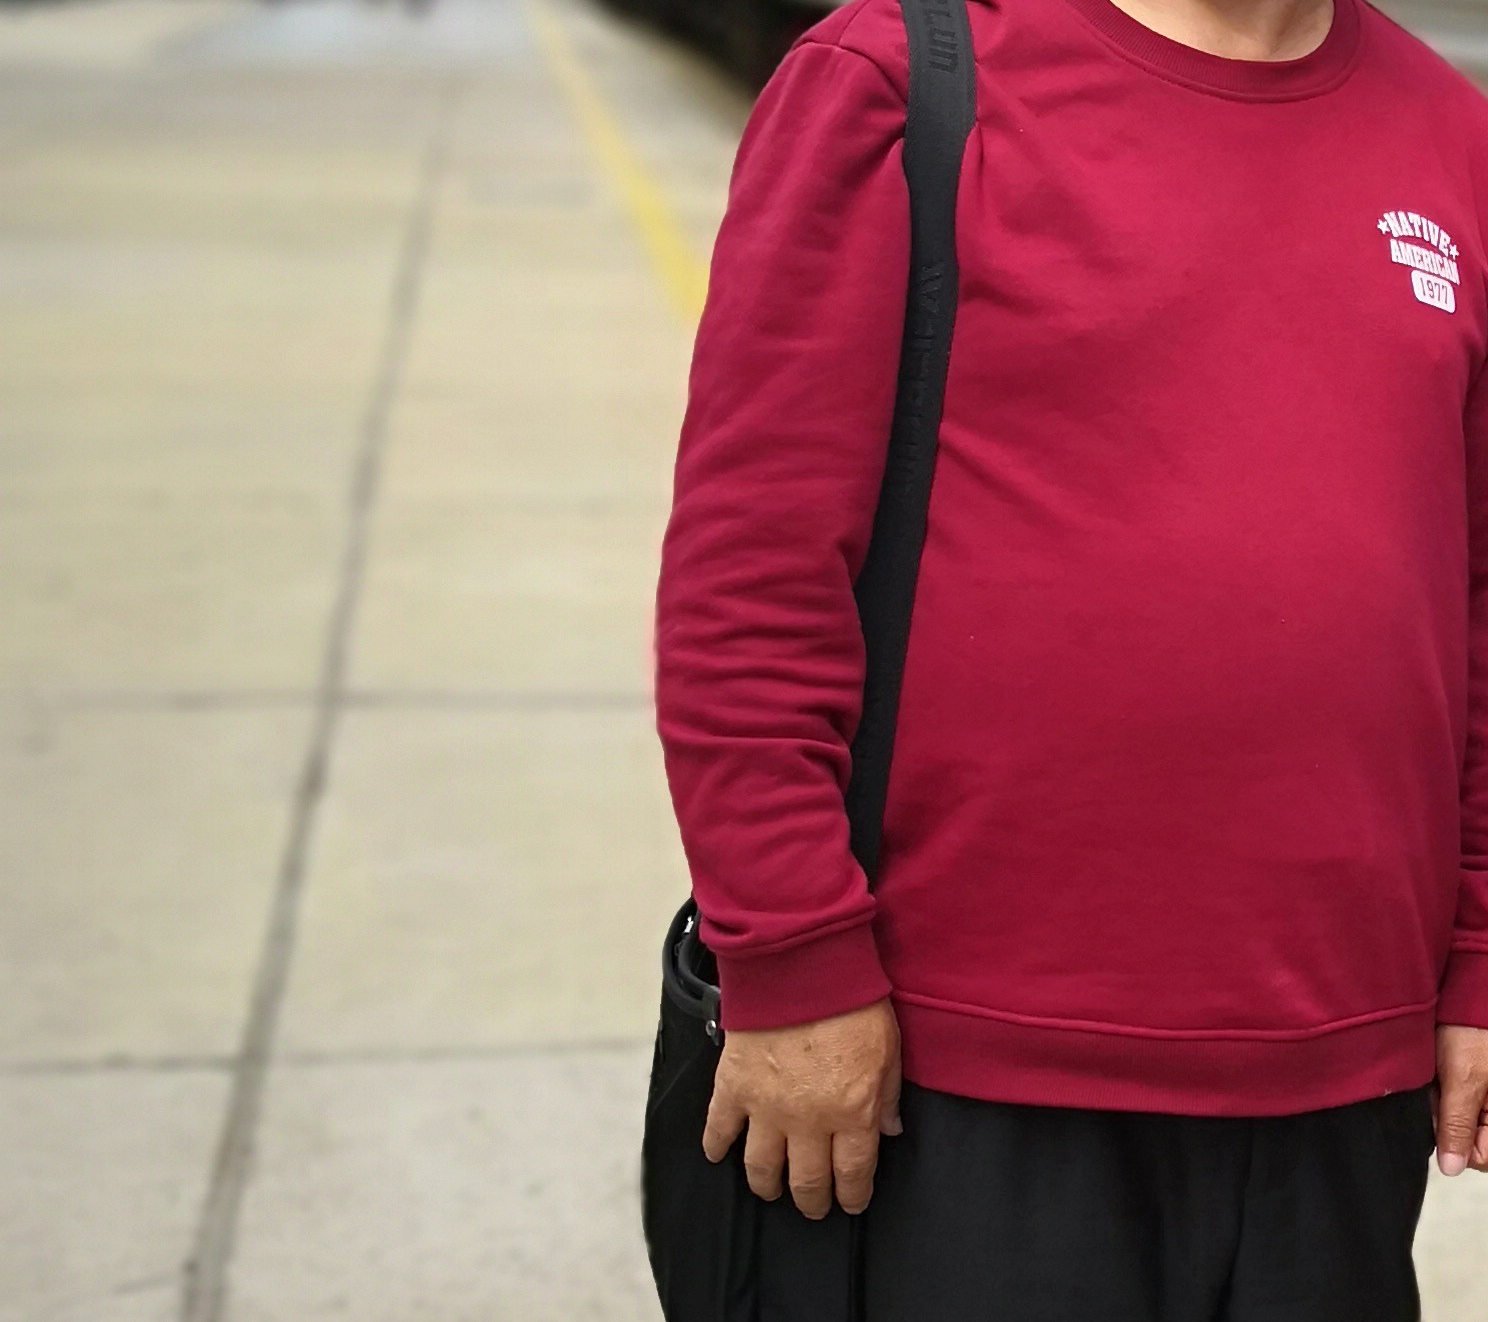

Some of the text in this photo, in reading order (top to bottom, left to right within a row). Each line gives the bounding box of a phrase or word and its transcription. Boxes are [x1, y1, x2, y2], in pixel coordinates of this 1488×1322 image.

[1384, 211, 1450, 257] NATIVE
[1390, 239, 1460, 285] AMERICAN
[1420, 277, 1448, 304] 1977
